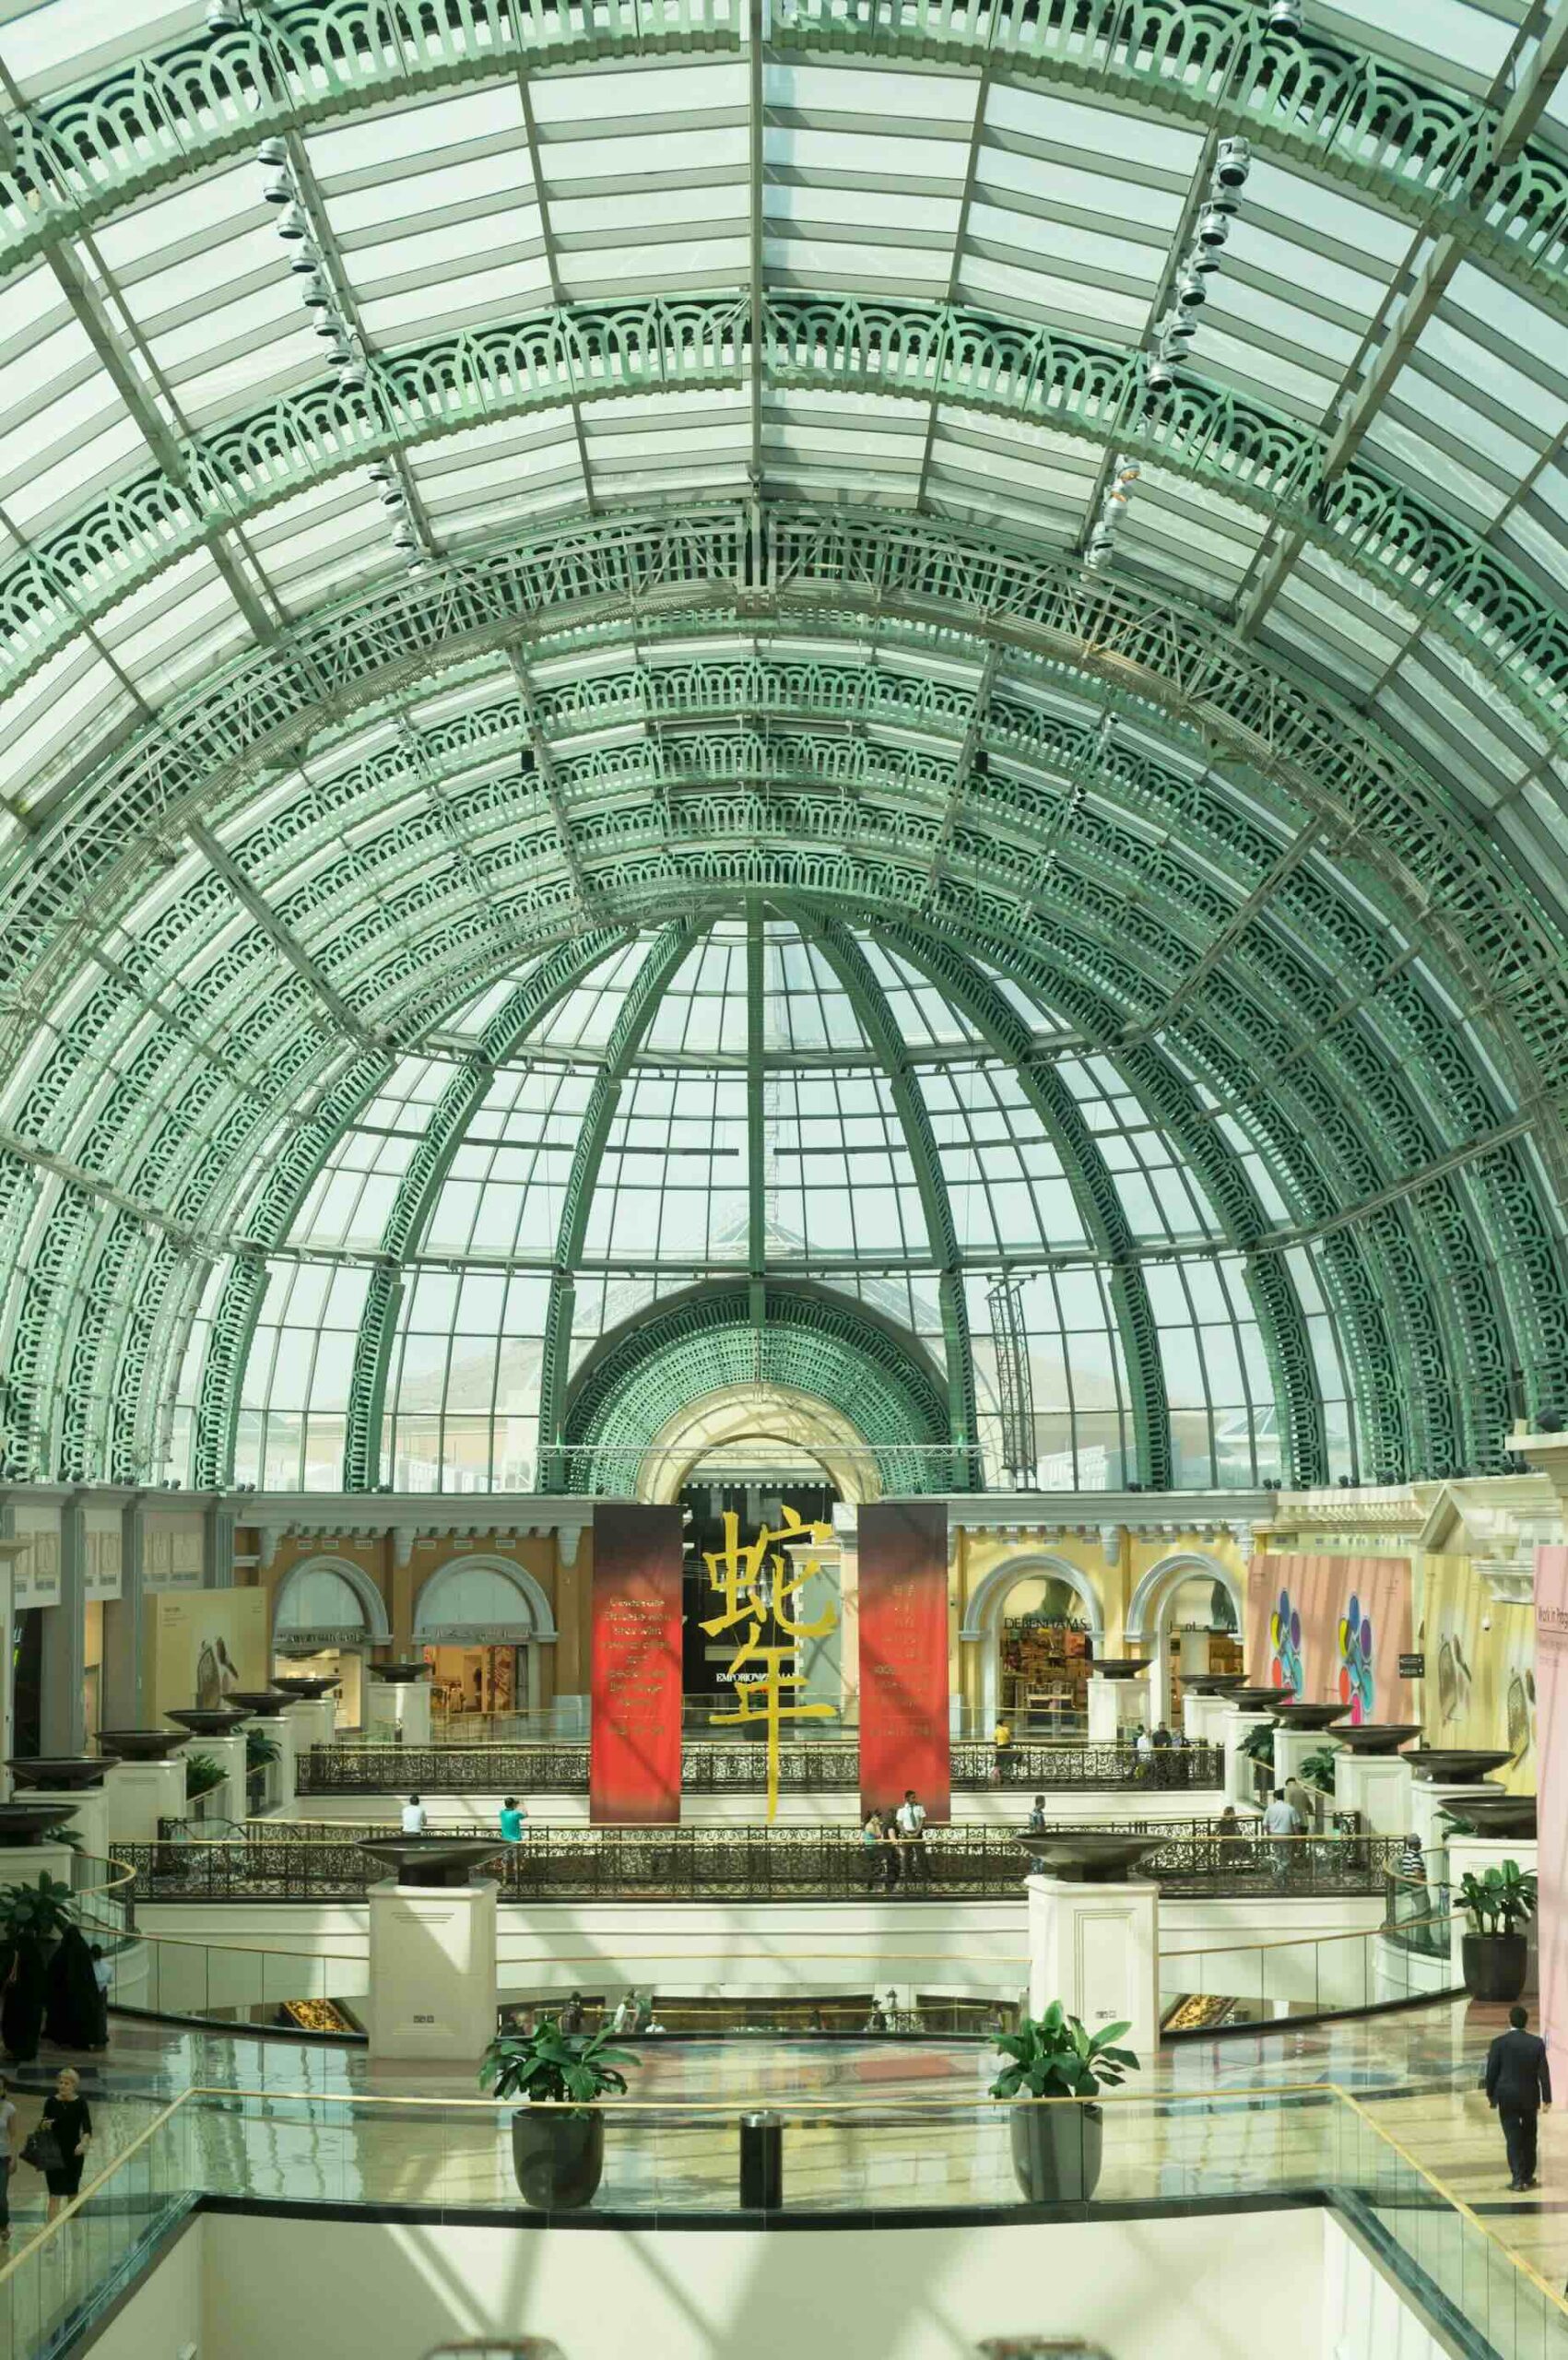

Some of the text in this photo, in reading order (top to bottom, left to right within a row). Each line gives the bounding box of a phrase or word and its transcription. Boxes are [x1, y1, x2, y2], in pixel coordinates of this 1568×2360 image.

[1004, 1618, 1089, 1630] DEBENHAMS
[698, 1504, 838, 1823] 蛇年
[716, 1673, 753, 1682] EMPORIO
